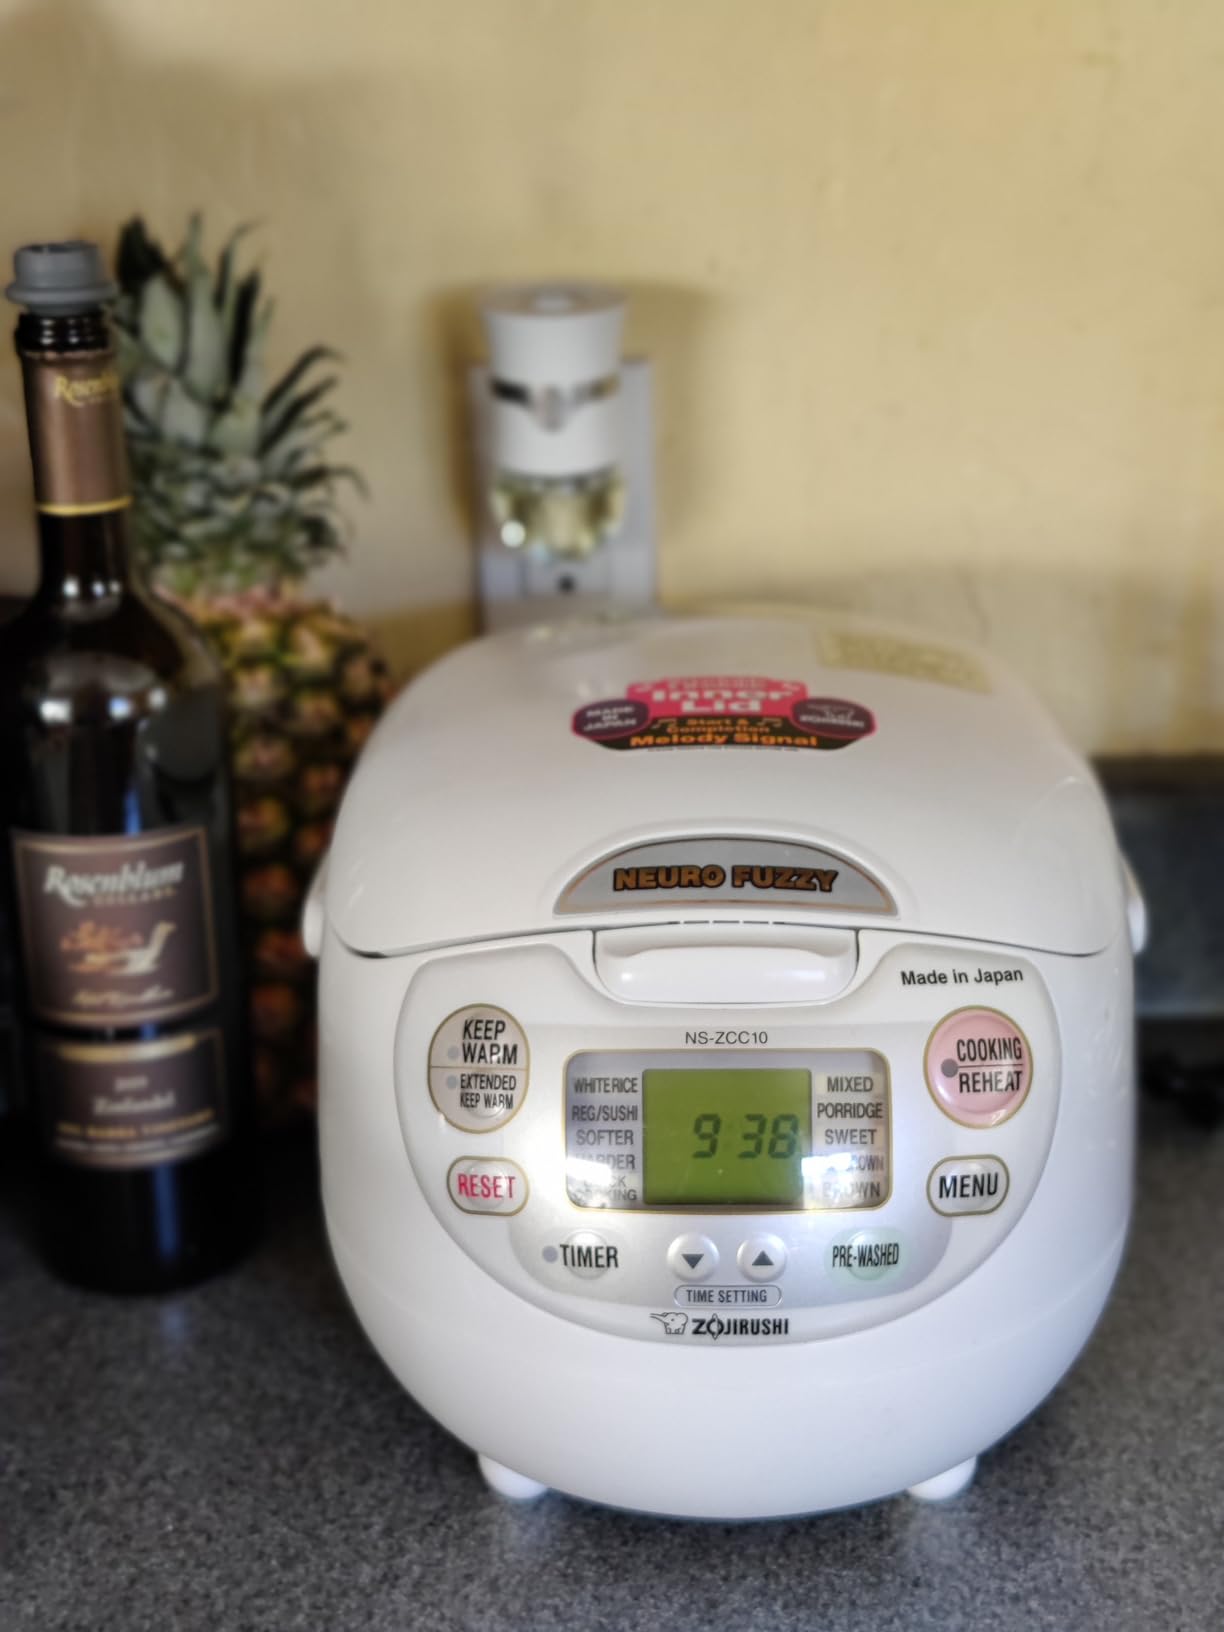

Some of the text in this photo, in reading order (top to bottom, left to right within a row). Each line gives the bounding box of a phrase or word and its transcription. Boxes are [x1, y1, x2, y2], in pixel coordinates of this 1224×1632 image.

[651, 689, 793, 702] Inner
[681, 700, 761, 714] Lid
[686, 718, 733, 727] Start
[630, 734, 817, 747] Melody Signal
[44, 861, 184, 907] Rosenblum
[613, 864, 838, 893] NEURO FUZZY
[901, 967, 1024, 986] Made in Japan
[462, 1018, 506, 1041] KEEP
[685, 1031, 769, 1045] NS-ZCC10
[462, 1042, 518, 1065] WARM
[957, 1037, 1022, 1062] COOKING
[460, 1073, 517, 1091] EXTENDED
[574, 1077, 638, 1093] WHITE RICE
[827, 1076, 874, 1093] MIXED
[959, 1071, 1022, 1094] REHEAT
[460, 1092, 514, 1110] KEEP WARM
[572, 1104, 637, 1122] REG/SUSHI
[817, 1103, 883, 1119] PORRIDGE
[576, 1129, 634, 1146] SOFTER
[825, 1129, 877, 1145] SWEET
[457, 1173, 516, 1199] RESET
[939, 1172, 999, 1199] MENU
[560, 1244, 618, 1269] TIMER
[831, 1244, 898, 1268] PRE-WASHED
[686, 1289, 766, 1304] TIME SETTING
[692, 1313, 788, 1341] ZOJIRUSHI
